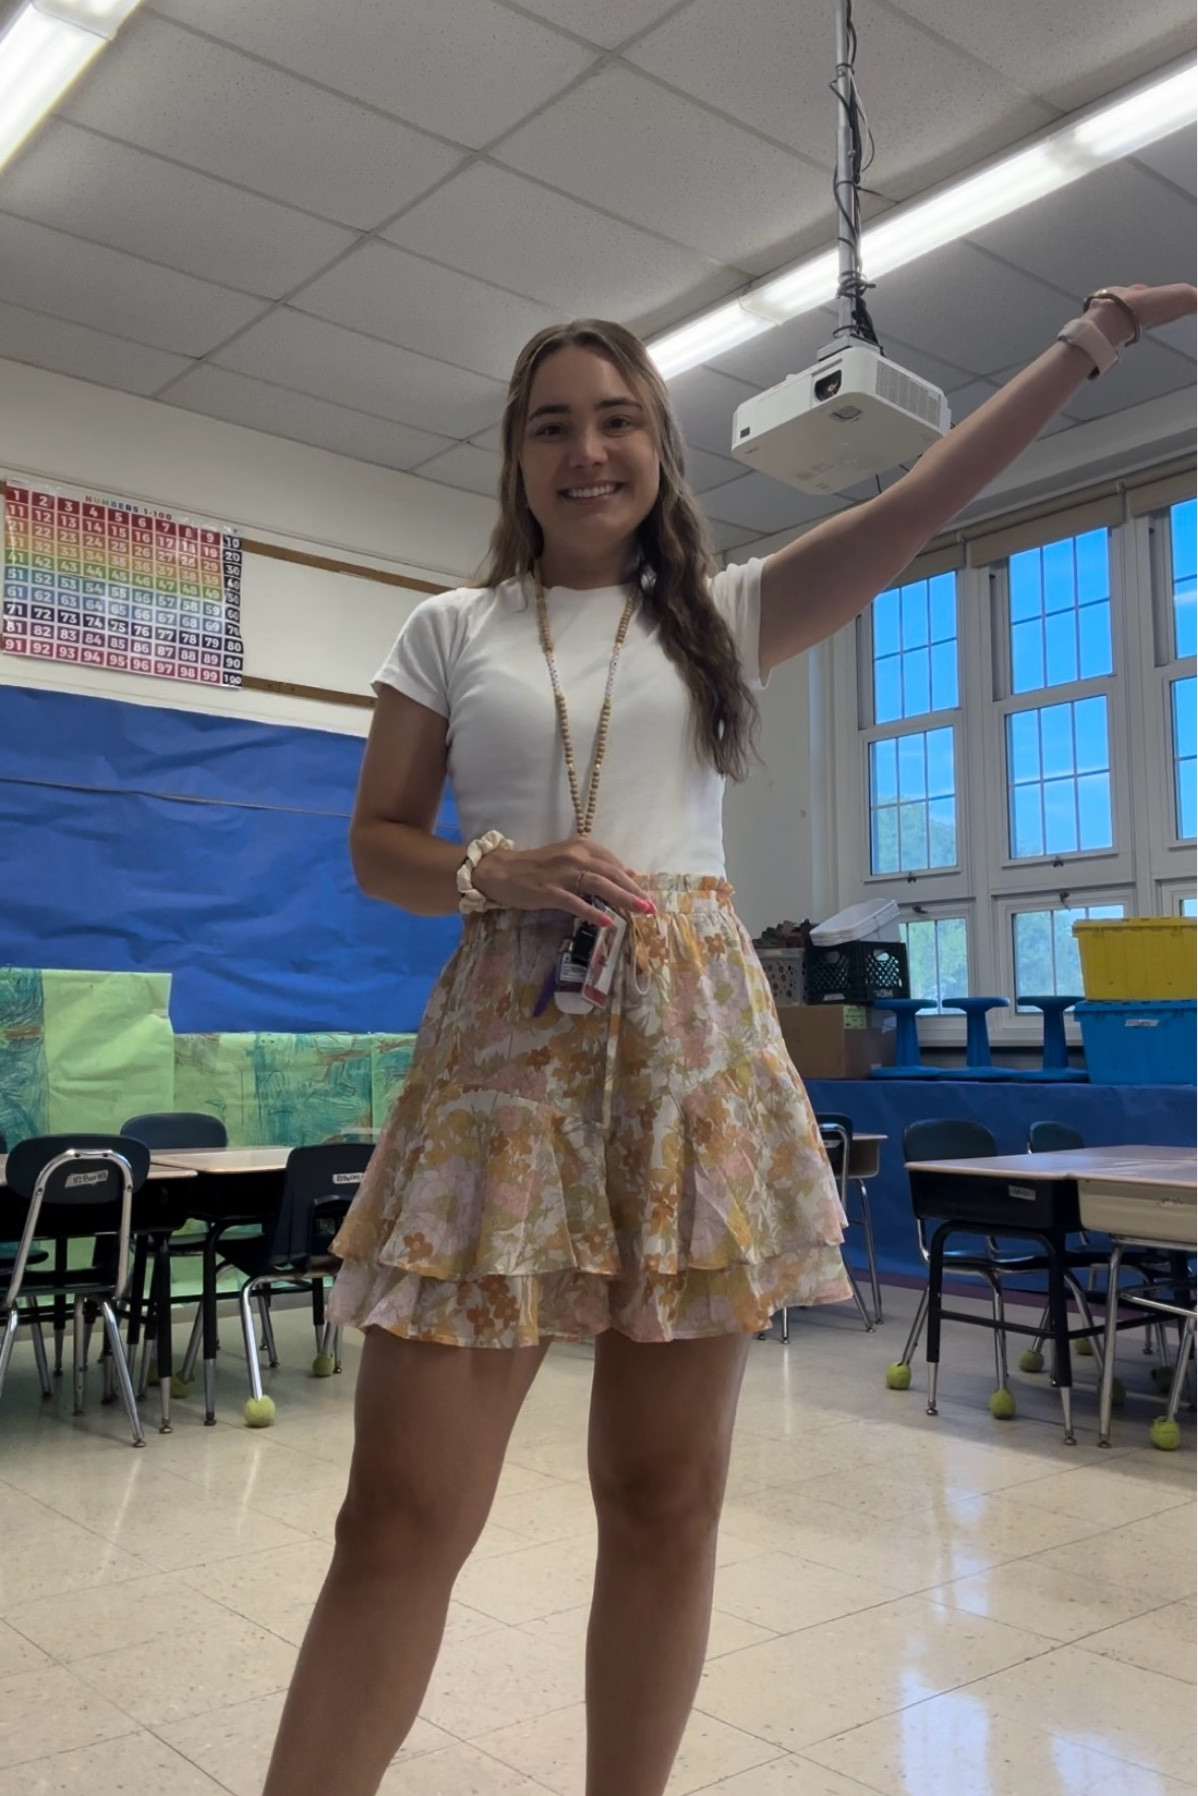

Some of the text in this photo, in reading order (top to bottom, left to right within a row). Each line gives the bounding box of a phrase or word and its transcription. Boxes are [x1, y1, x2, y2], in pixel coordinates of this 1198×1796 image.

[14, 490, 239, 548] 1 2 3 4 5 6 7 8 9 10
[85, 495, 172, 520] NUMBERS 1-100
[8, 520, 24, 532] 21
[35, 526, 51, 538] 22
[61, 531, 76, 543] 23
[86, 536, 102, 548] 24
[111, 541, 126, 553] 25
[134, 546, 150, 558] 26
[158, 552, 173, 563] 27
[203, 561, 217, 572] 29
[226, 564, 240, 576] 30
[9, 504, 24, 517] 11
[35, 510, 51, 523] 12
[61, 516, 76, 528] 13
[86, 521, 102, 533] 14
[111, 526, 126, 538] 15
[134, 531, 150, 543] 16
[158, 536, 173, 548] 17
[203, 546, 217, 558] 19
[225, 551, 240, 562] 20
[8, 551, 24, 563] 41
[35, 556, 51, 568] 42
[61, 561, 77, 573] 43
[86, 565, 102, 577] 44
[111, 570, 127, 581] 45
[135, 575, 150, 587] 46
[159, 580, 174, 591] 47
[182, 584, 197, 595] 48
[205, 588, 219, 599] 49
[35, 541, 51, 553] 32
[61, 546, 76, 557] 33
[86, 550, 102, 562] 34
[111, 555, 126, 567] 35
[134, 560, 150, 573] 36
[158, 566, 173, 576] 37
[182, 571, 196, 581] 38
[204, 575, 218, 586] 39
[7, 585, 23, 598] 61
[34, 590, 51, 602] 62
[61, 595, 76, 607] 63
[86, 600, 102, 611] 64
[111, 604, 126, 616] 65
[134, 608, 150, 620] 66
[158, 612, 174, 624] 67
[182, 616, 197, 628] 68
[8, 567, 24, 580] 51
[34, 572, 51, 584] 52
[61, 577, 76, 589] 53
[85, 582, 102, 594] 54
[111, 587, 126, 598] 55
[134, 591, 150, 603] 56
[158, 595, 173, 607] 57
[182, 600, 197, 612] 58
[205, 604, 219, 616] 59
[6, 621, 240, 668] 81 82 83 84 85 86 87 88 89 90
[7, 603, 241, 652] 71 72 73 74 75 76 77 78 79 80
[5, 639, 21, 650] 91
[33, 642, 50, 655] 92
[59, 647, 75, 658] 93
[84, 650, 100, 663] 94
[109, 655, 124, 667] 95
[133, 659, 148, 671] 96
[157, 663, 173, 674] 97
[180, 666, 195, 677] 98
[203, 670, 217, 680] 99
